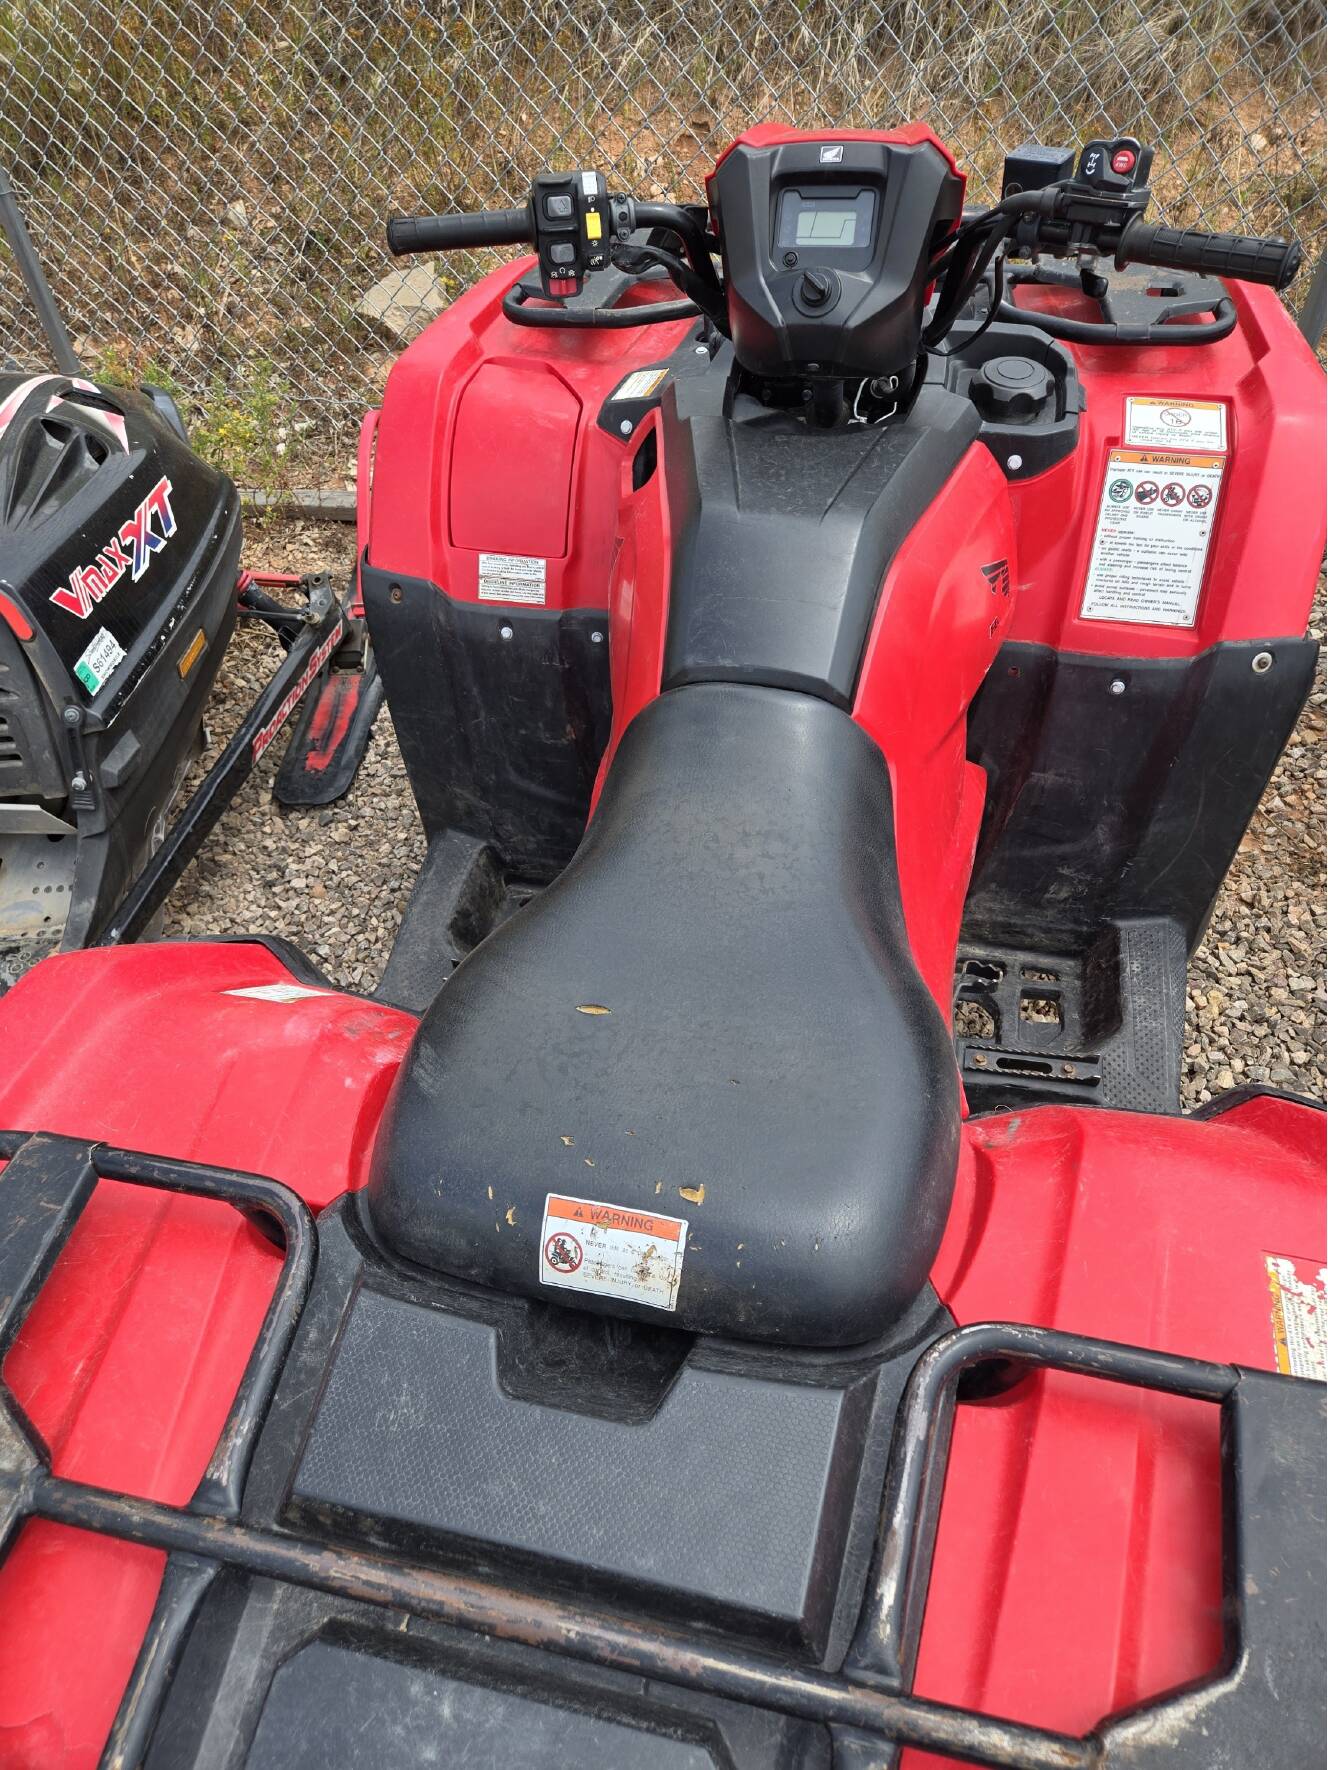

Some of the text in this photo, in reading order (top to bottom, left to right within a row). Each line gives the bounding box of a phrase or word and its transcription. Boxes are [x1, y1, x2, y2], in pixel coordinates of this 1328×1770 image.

[1151, 455, 1191, 465] WARNING
[118, 475, 178, 583] XT
[92, 639, 116, 673] S61494
[590, 1207, 655, 1232] WARNING
[585, 1239, 607, 1249] NEVER
